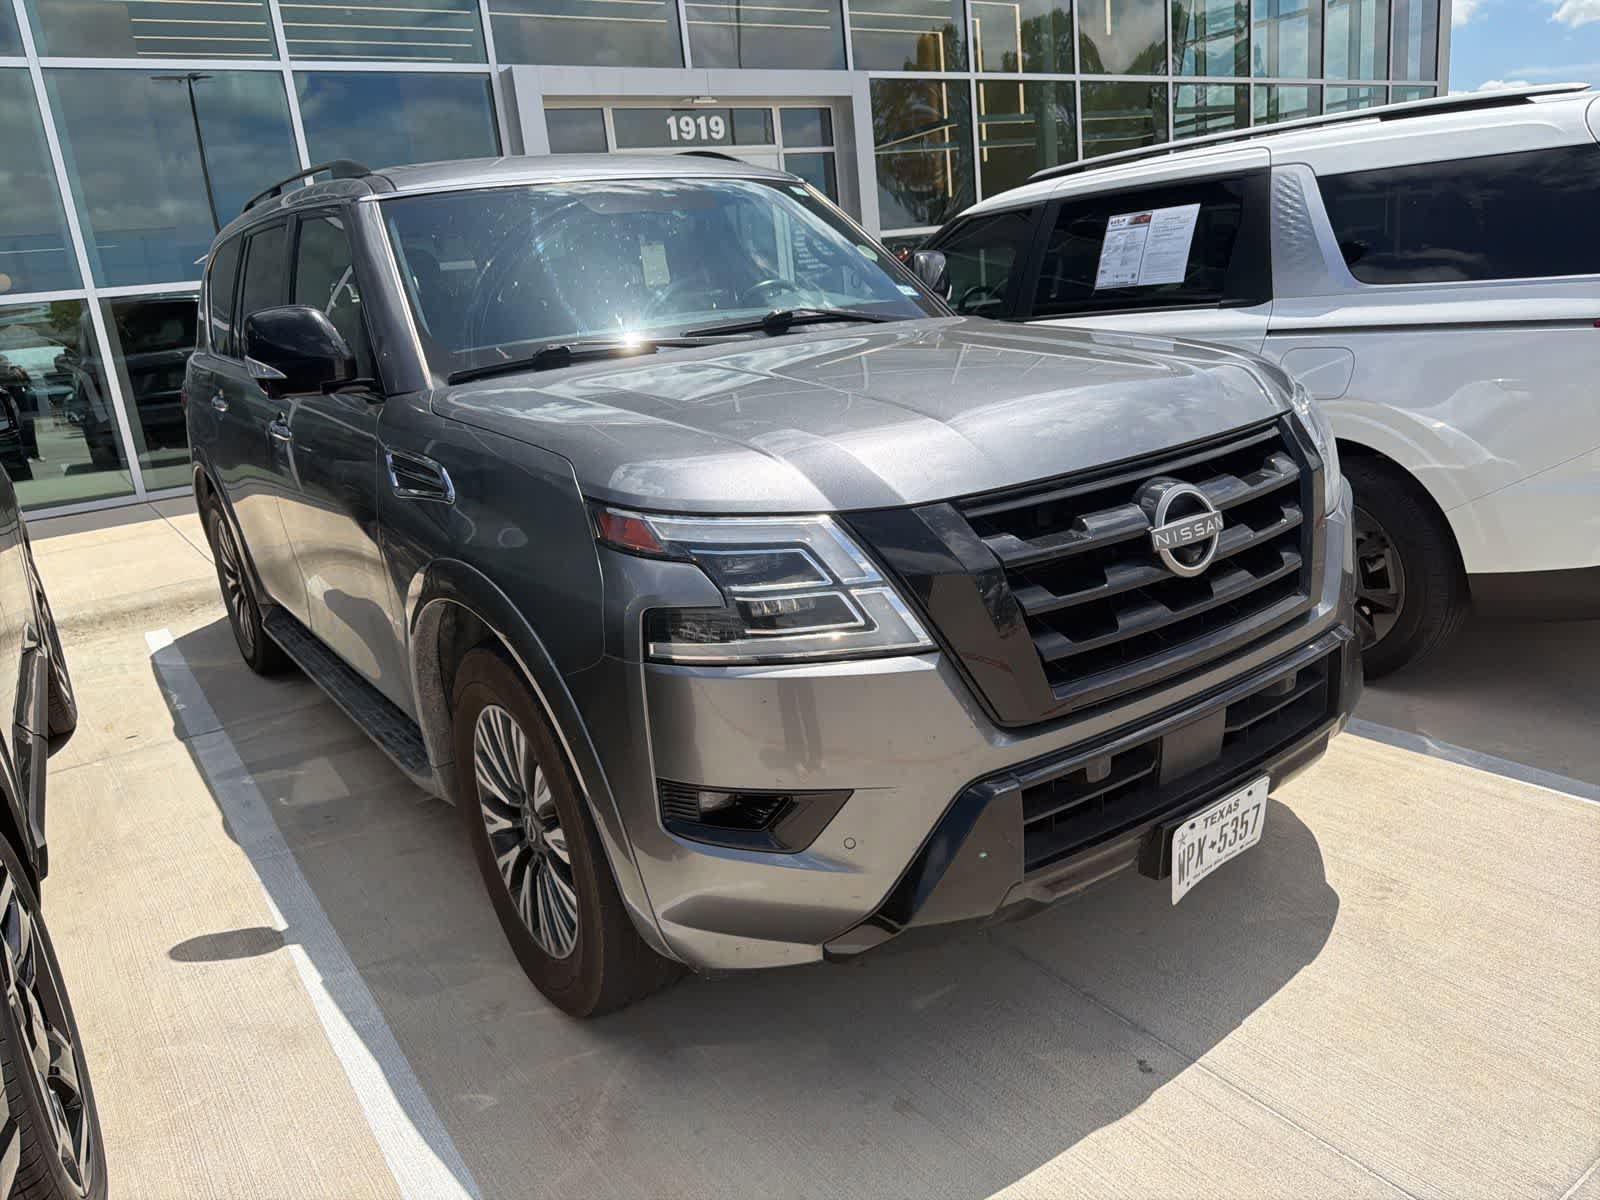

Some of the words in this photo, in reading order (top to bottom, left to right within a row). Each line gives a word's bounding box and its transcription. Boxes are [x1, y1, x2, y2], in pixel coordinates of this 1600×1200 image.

[666, 115, 725, 141] 1919
[1154, 516, 1223, 547] NISSAN
[1202, 799, 1240, 829] TEXAS
